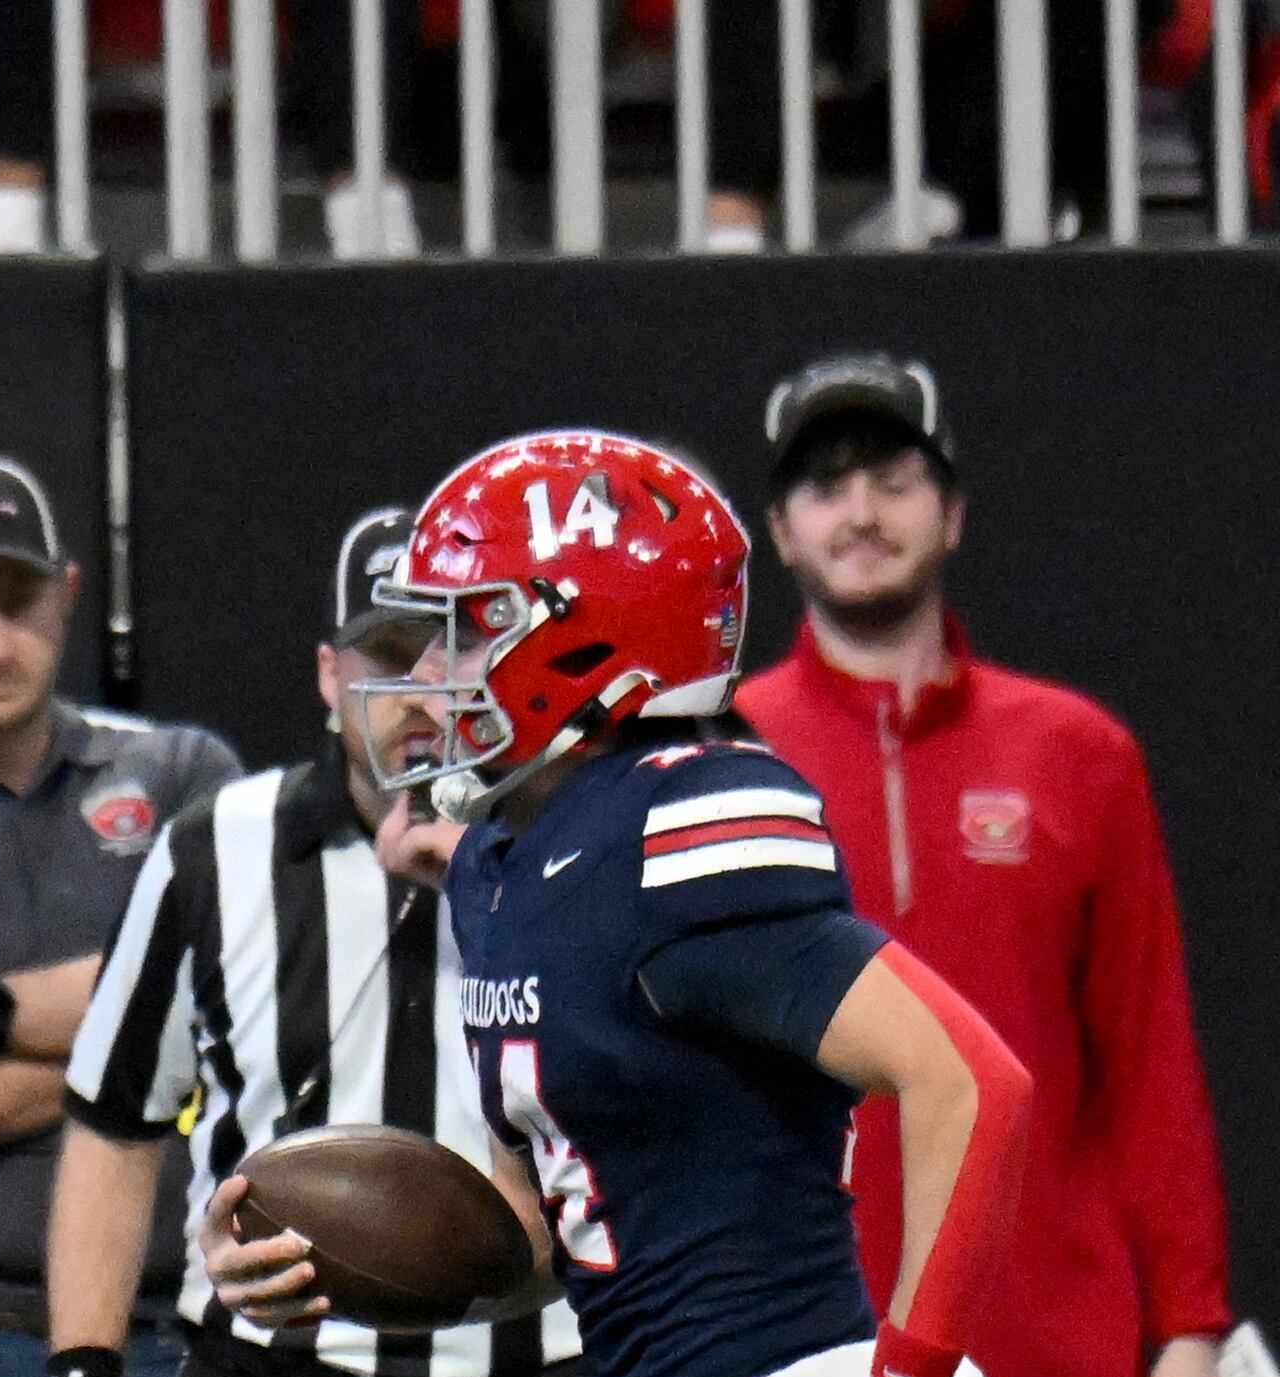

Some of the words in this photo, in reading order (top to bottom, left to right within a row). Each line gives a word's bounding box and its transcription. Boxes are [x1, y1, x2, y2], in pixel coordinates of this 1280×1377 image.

[522, 471, 620, 563] 14
[459, 976, 540, 1028] ULLDOGS
[472, 1038, 618, 1272] 4
